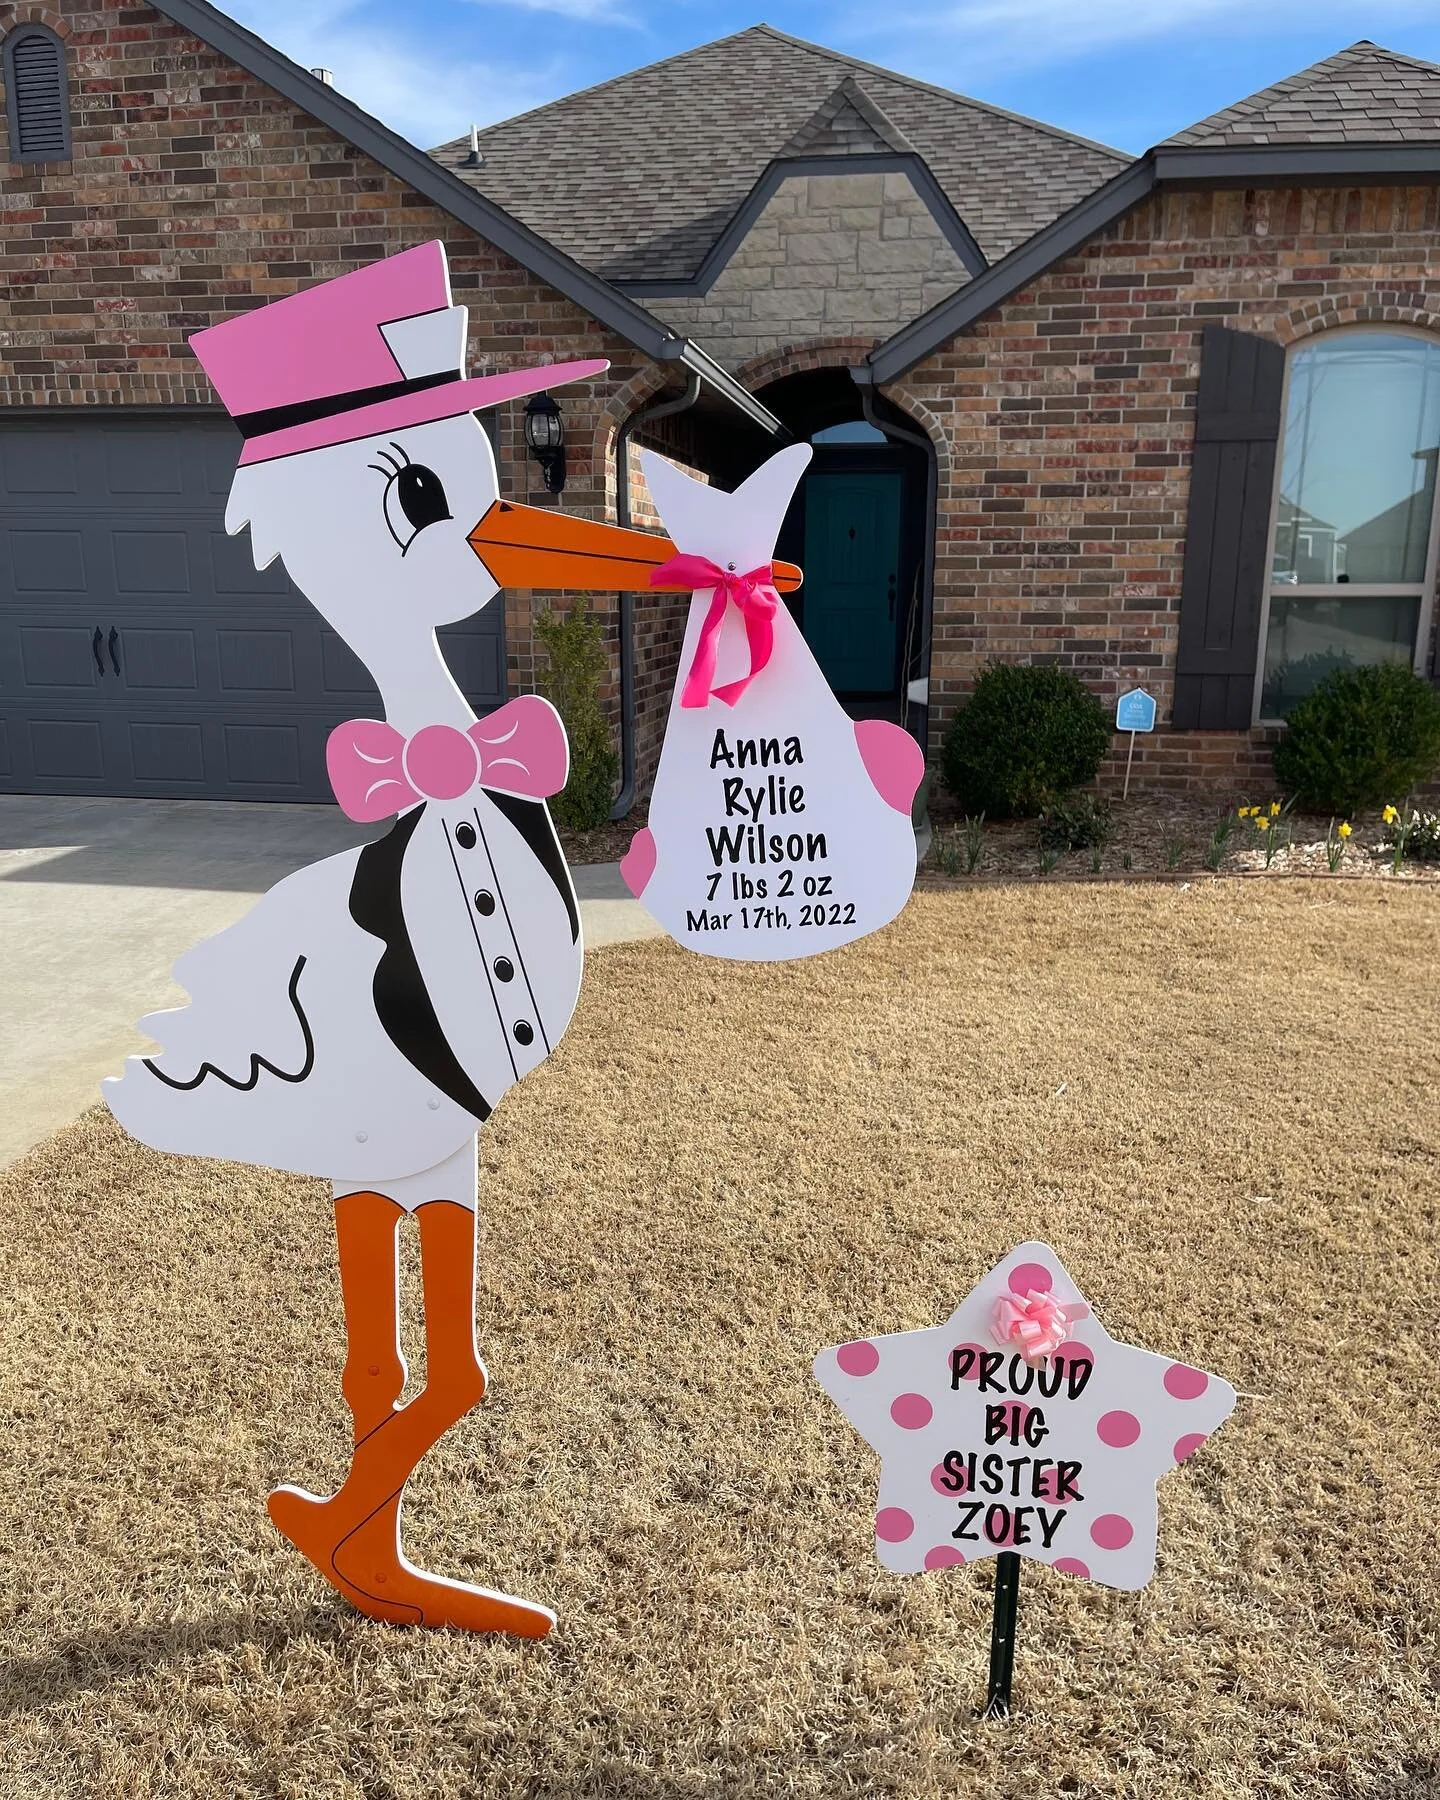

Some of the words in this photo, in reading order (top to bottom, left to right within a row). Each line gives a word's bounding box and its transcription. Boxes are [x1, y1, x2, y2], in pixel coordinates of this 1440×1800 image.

[710, 728, 804, 770] Anna
[722, 774, 806, 823] Rylie
[705, 823, 828, 867] Wilson
[706, 871, 723, 901] 7
[732, 871, 769, 901] lbs
[776, 869, 795, 898] 2
[803, 875, 833, 897] oz
[686, 908, 733, 932] Mar
[740, 905, 792, 930] 17th,
[798, 902, 857, 927] 2022
[950, 1348, 1094, 1401] PROUD
[984, 1404, 1050, 1448] BIG
[939, 1450, 1085, 1501] SISTER
[951, 1500, 1068, 1549] ZOEY
